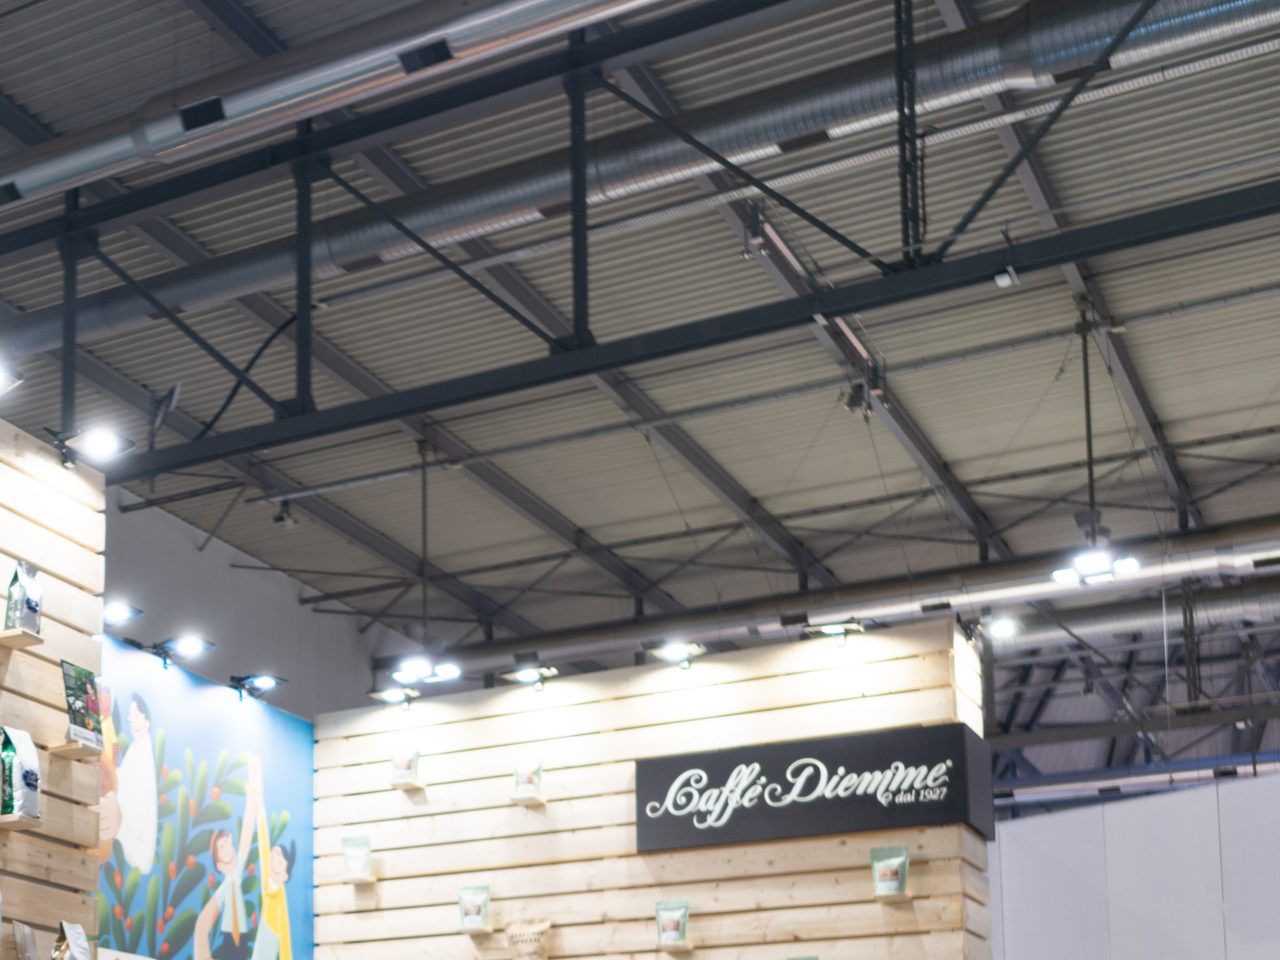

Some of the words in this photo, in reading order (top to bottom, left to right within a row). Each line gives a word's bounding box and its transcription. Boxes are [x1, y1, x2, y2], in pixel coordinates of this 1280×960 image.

[645, 761, 767, 829] Caffè
[764, 757, 951, 807] Diemme
[894, 790, 917, 805] dal
[919, 786, 949, 802] 1927
